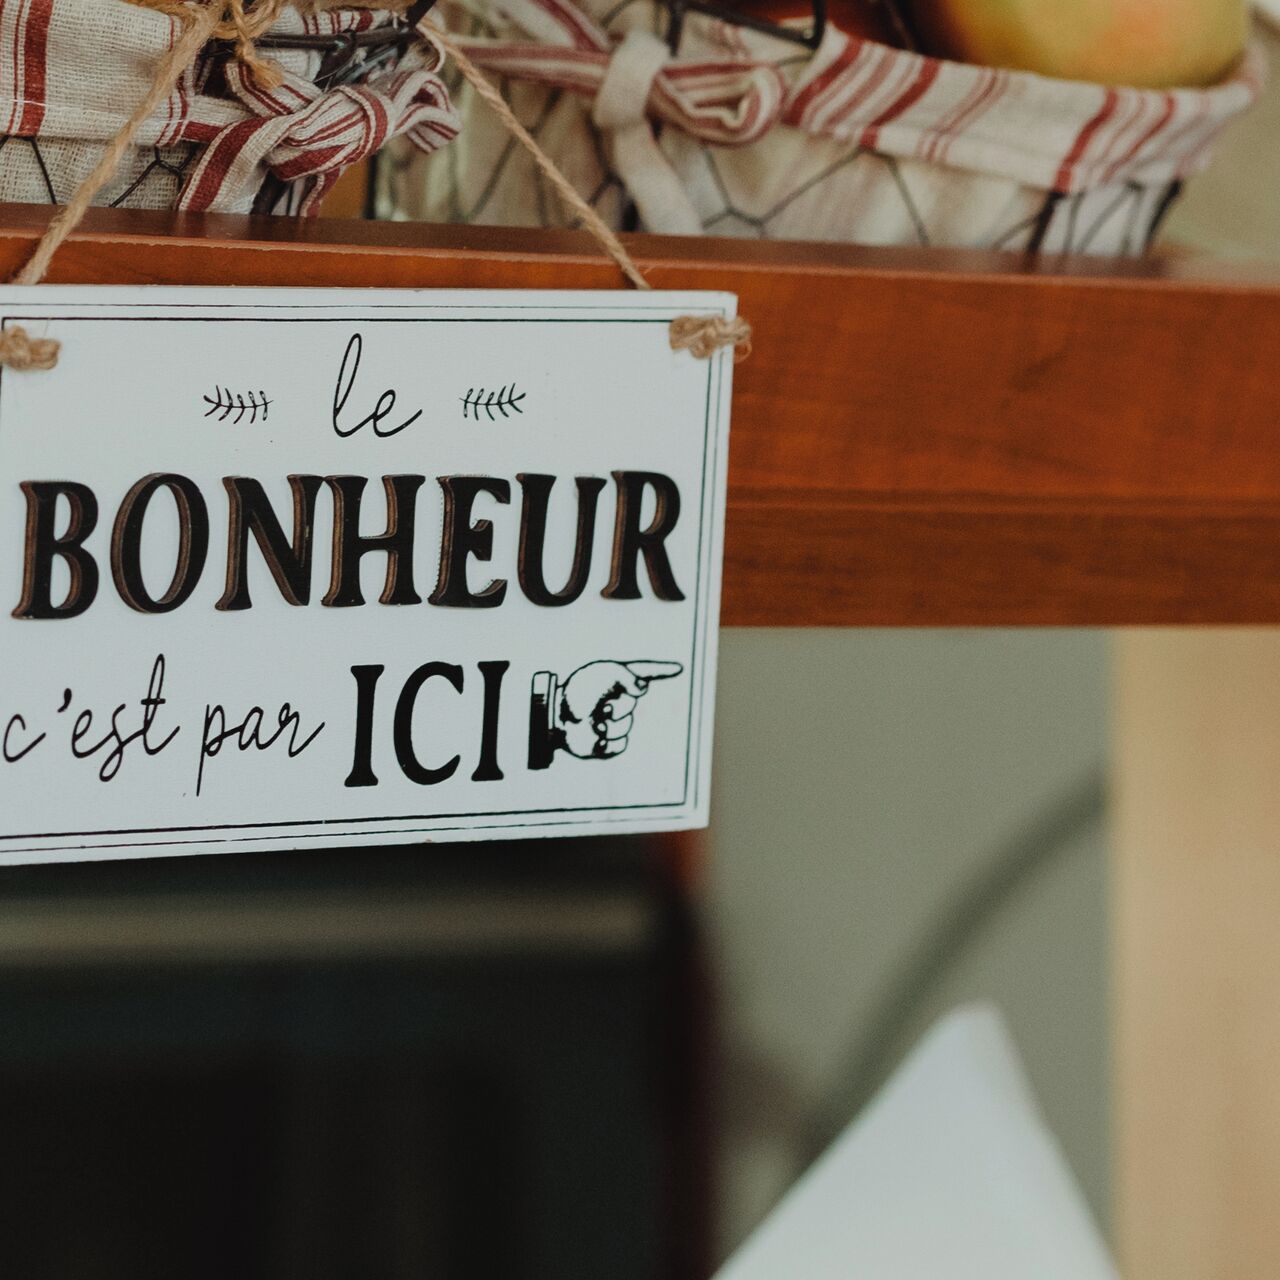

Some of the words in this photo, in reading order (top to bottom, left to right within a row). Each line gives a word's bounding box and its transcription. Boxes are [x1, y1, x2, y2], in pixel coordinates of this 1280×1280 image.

[332, 332, 423, 438] le
[11, 471, 686, 621] BONHEUR
[2, 653, 181, 783] c'est
[195, 702, 326, 797] par
[343, 659, 511, 788] ICI
